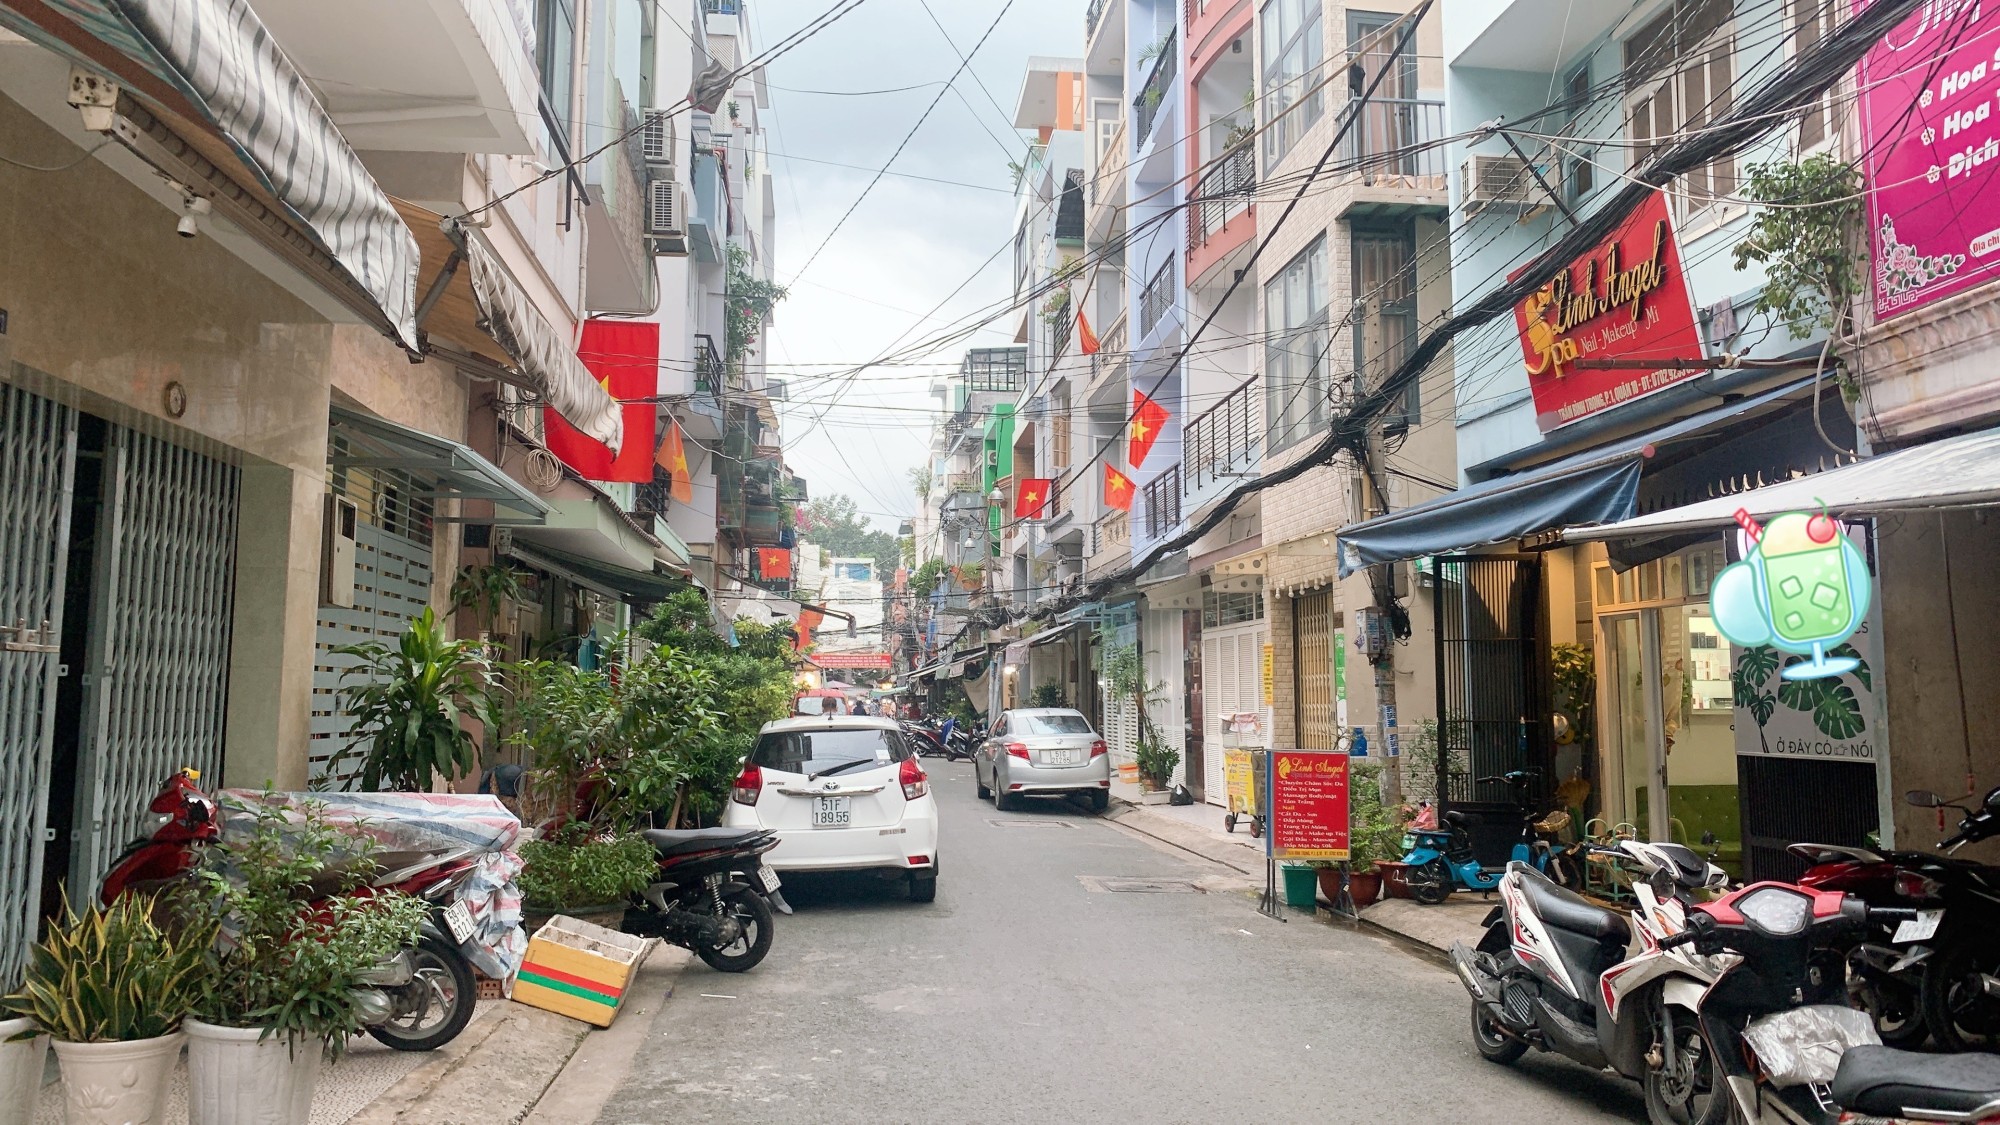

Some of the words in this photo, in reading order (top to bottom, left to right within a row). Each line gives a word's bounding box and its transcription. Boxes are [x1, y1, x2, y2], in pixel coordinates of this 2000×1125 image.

[1940, 61, 1987, 100] Hoa
[1943, 101, 1990, 140] Hoa
[1948, 137, 1999, 178] Dịch
[1551, 258, 1598, 336] Linh
[1599, 219, 1667, 322] Angel
[1645, 307, 1659, 330] Mi
[1776, 736, 1786, 752] Ở
[1788, 738, 1812, 754] ĐÂY
[1814, 740, 1832, 756] CÓ
[1850, 739, 1873, 758] NỐI
[1291, 758, 1312, 772] Linh
[1315, 759, 1345, 778] Angel
[822, 799, 842, 811] 51F
[814, 812, 849, 824] 189.55
